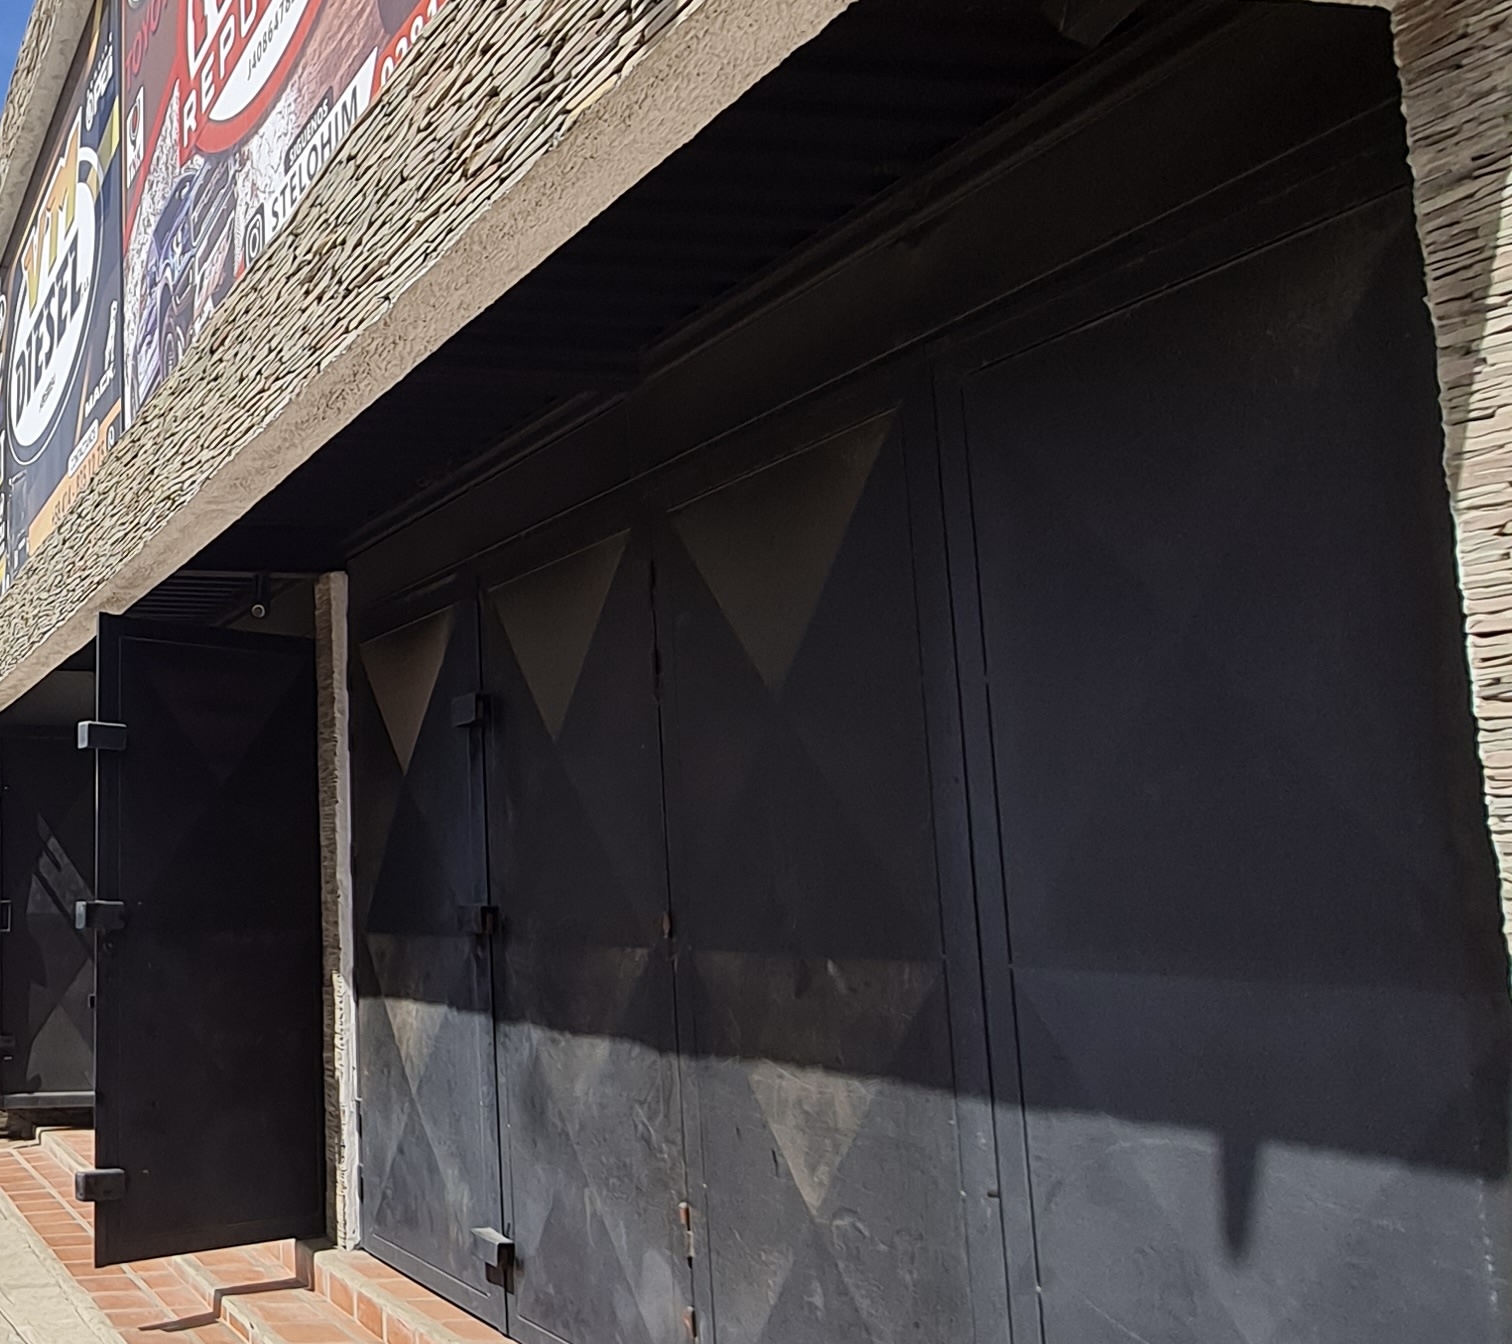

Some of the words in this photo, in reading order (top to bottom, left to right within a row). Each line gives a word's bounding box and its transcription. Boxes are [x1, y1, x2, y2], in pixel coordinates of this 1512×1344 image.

[271, 85, 358, 233] STELOHIM
[15, 226, 83, 429] DIESEL
[84, 362, 114, 419] MACK
